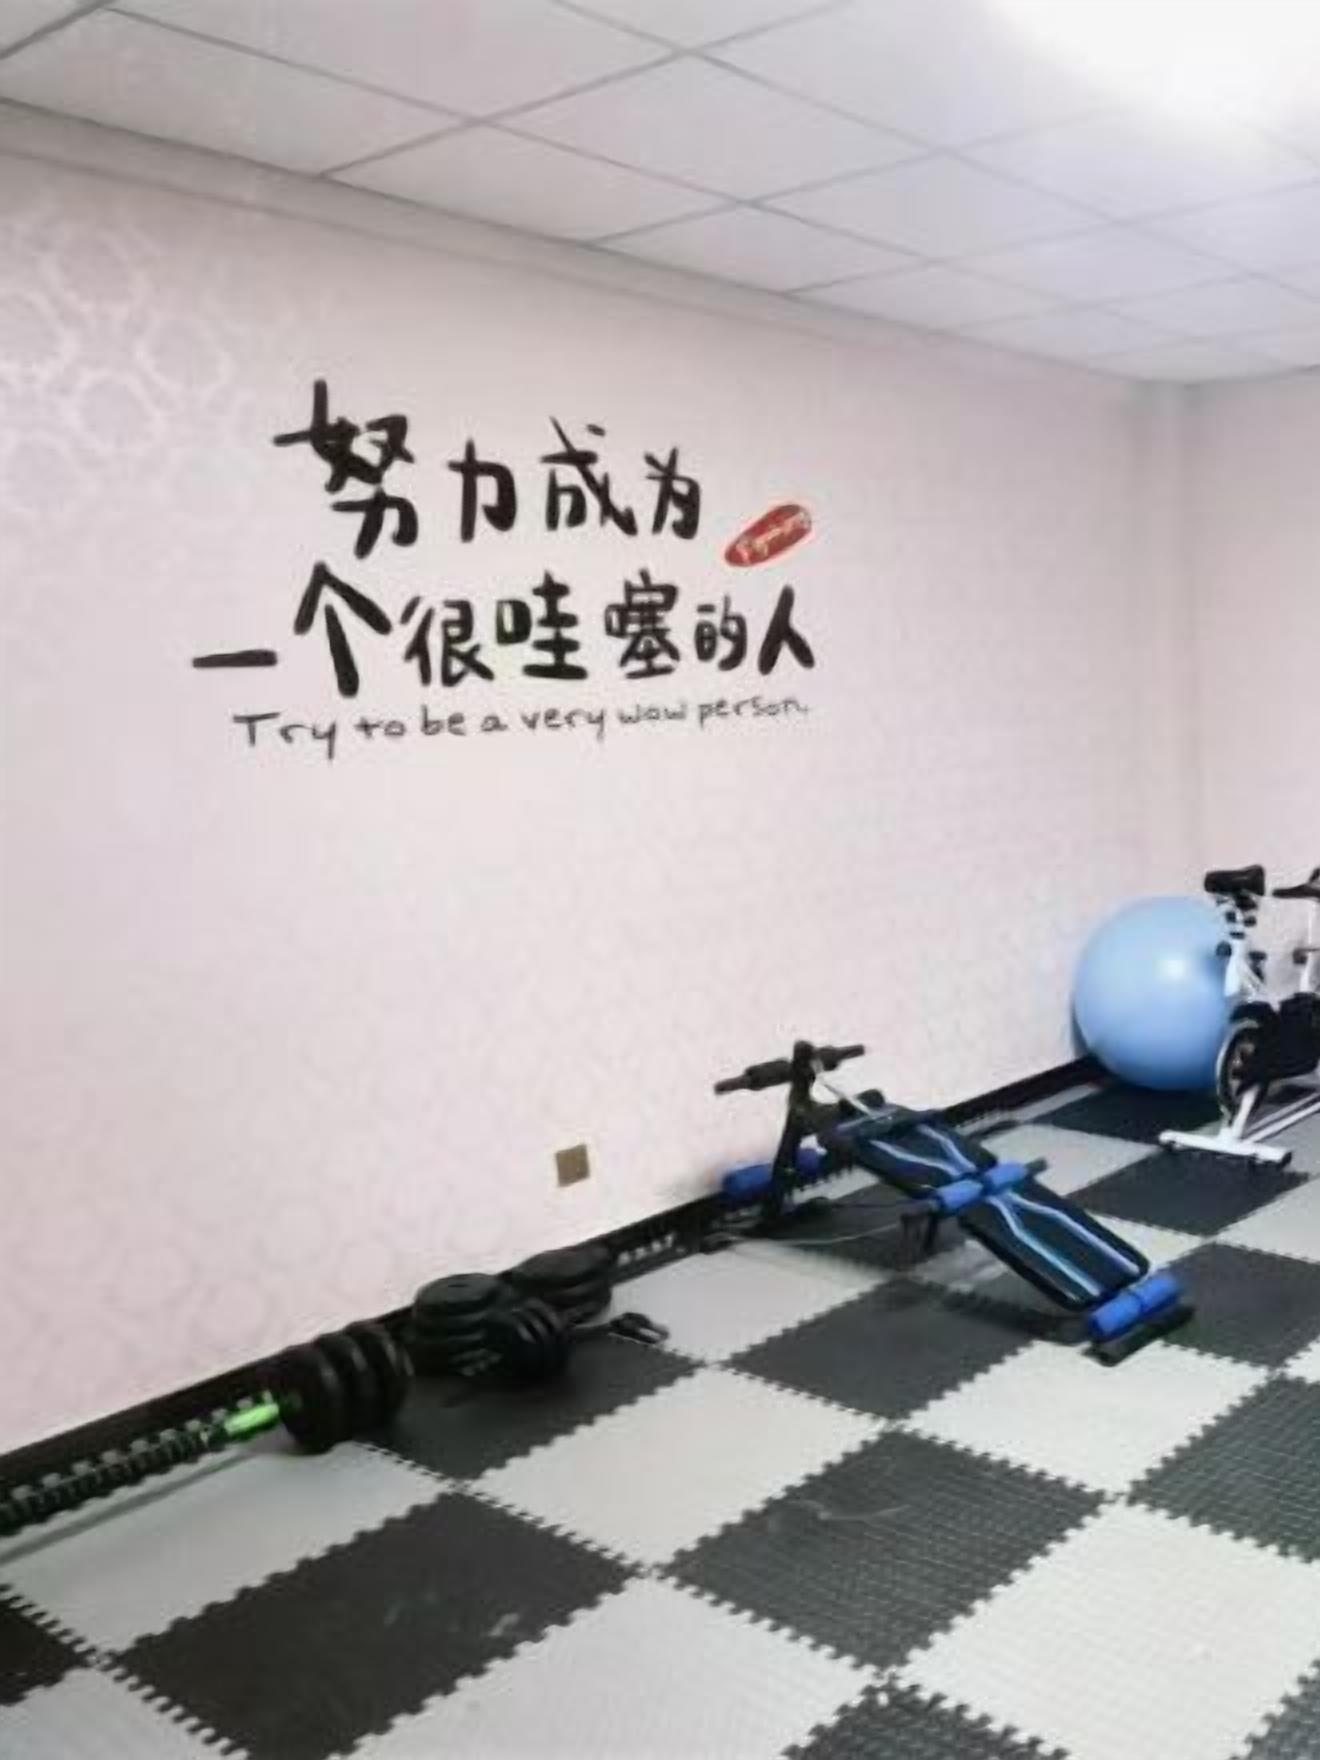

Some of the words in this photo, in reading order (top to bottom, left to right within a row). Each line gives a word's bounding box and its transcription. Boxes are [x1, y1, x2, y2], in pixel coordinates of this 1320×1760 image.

[273, 379, 701, 559] 努力成为
[232, 711, 338, 761] Try
[354, 717, 407, 740] to
[420, 704, 466, 737] be
[480, 714, 509, 733] a
[520, 707, 606, 742] very
[616, 703, 688, 726] wow
